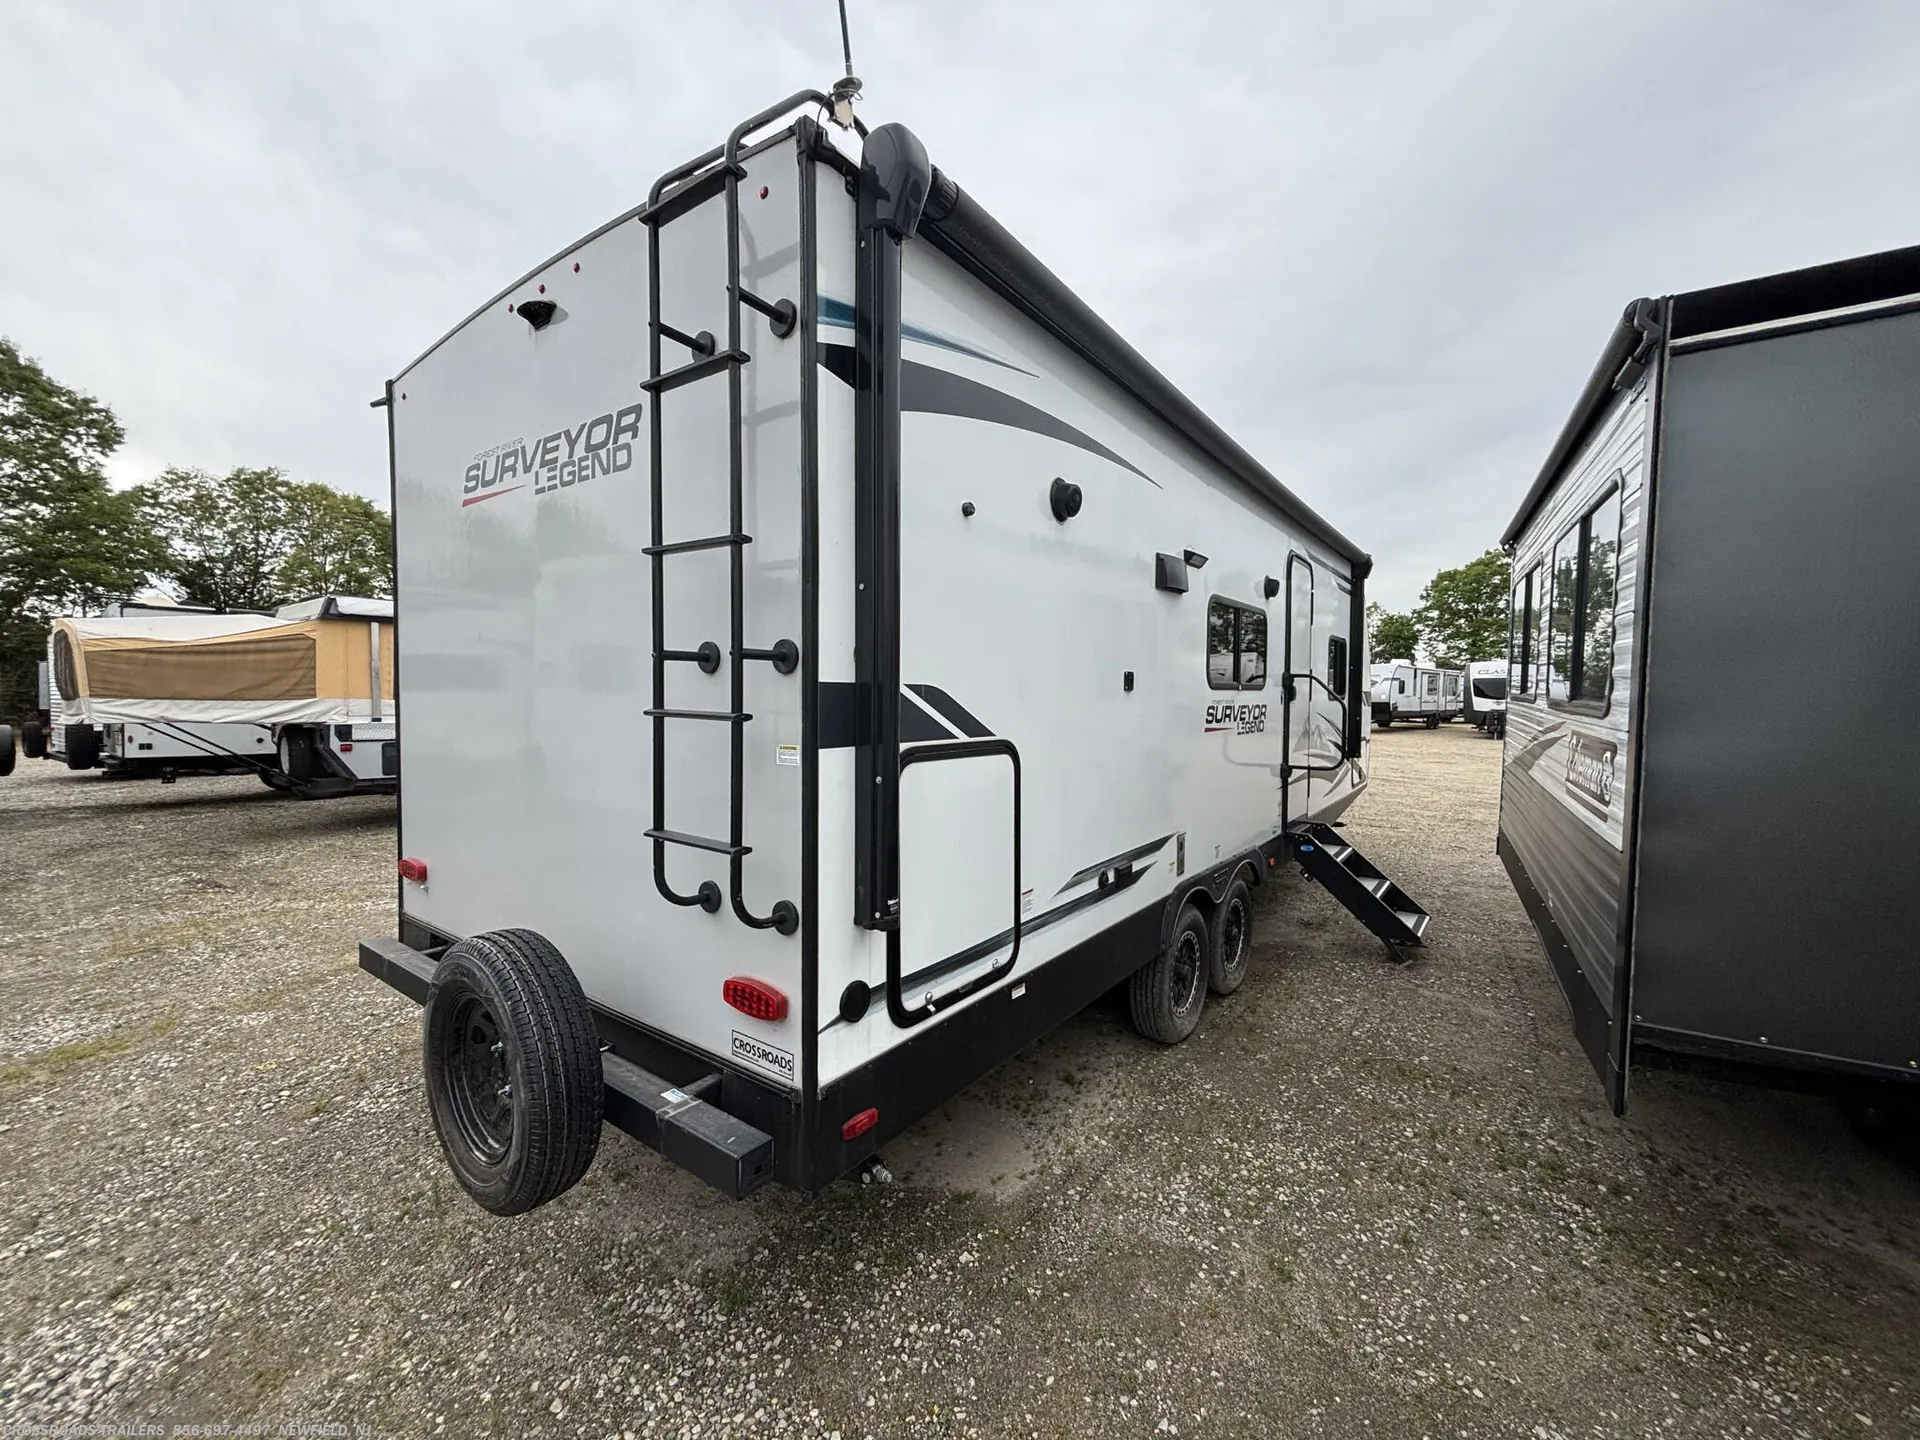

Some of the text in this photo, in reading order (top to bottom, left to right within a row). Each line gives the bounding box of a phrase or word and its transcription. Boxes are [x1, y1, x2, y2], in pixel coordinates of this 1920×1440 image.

[463, 403, 643, 494] SURVEYOR
[535, 442, 632, 496] LEGEND
[1205, 704, 1267, 724] SURVEYOR
[1237, 720, 1265, 735] LEGEND
[733, 1037, 793, 1072] CROSSROADS
